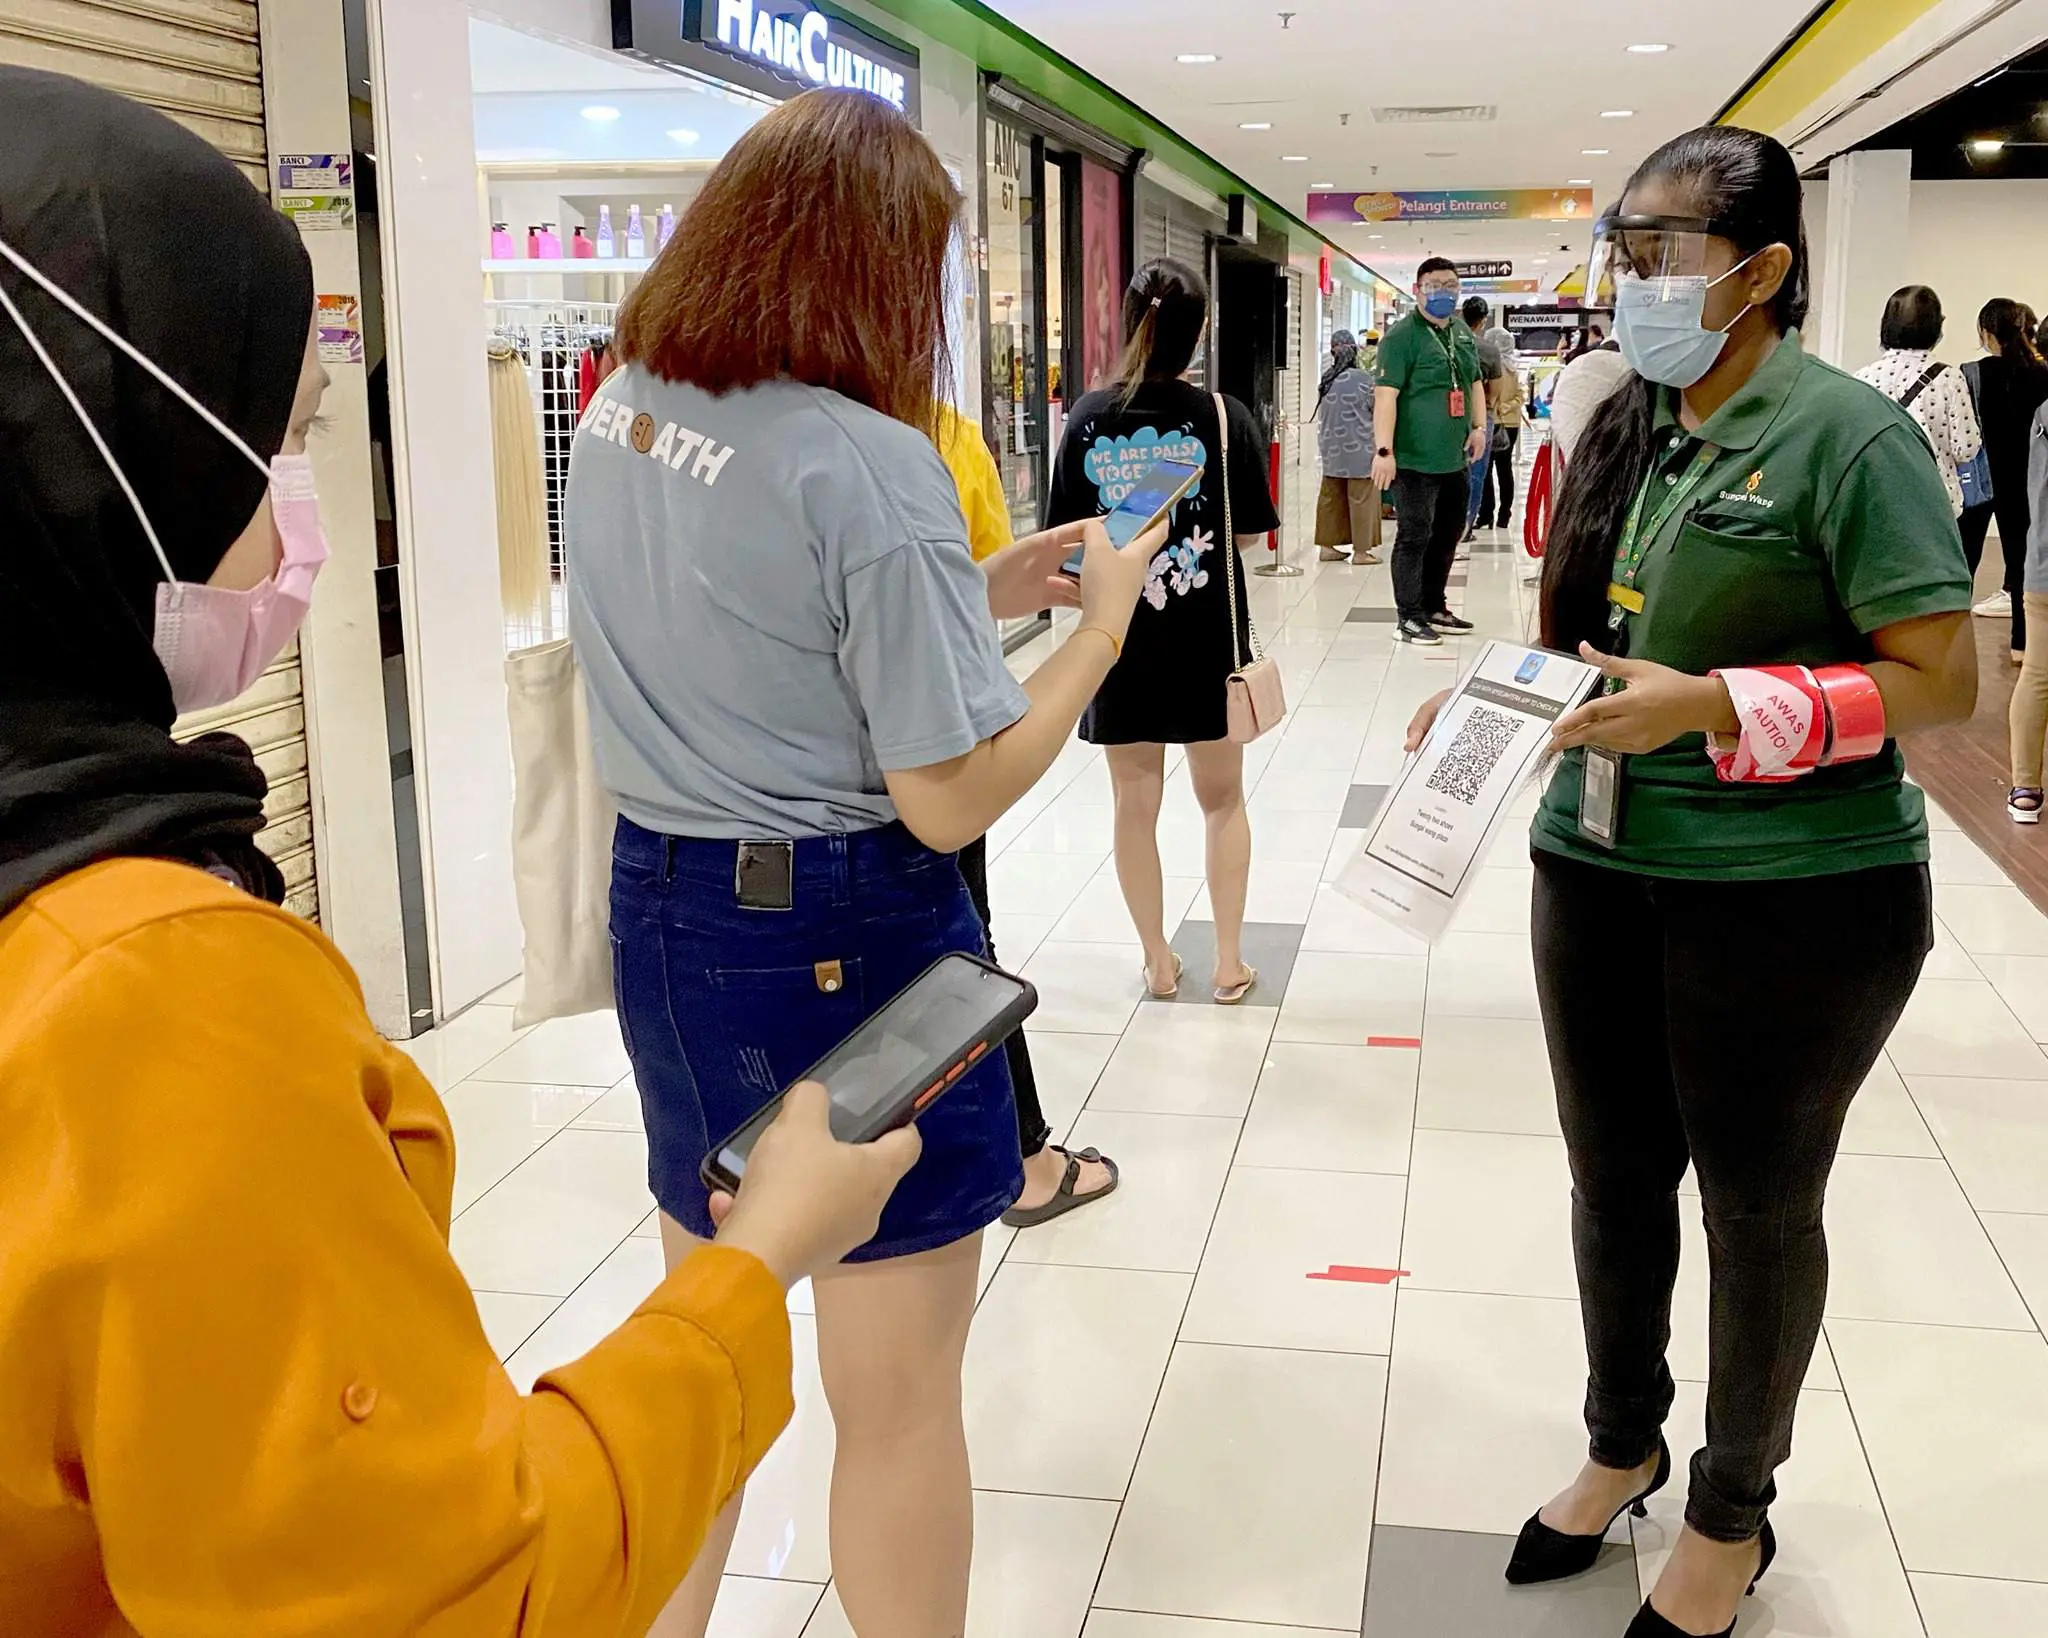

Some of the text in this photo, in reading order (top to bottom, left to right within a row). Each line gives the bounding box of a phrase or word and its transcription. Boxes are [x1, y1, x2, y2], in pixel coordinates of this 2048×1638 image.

[280, 157, 305, 165] BANCI
[1002, 181, 1014, 211] 67
[1399, 199, 1446, 214] Pelangi
[1450, 199, 1507, 211] Entrance
[1509, 315, 1563, 324] WENAWAVE
[1091, 440, 1200, 465] WE ARE PALS!
[1767, 695, 1805, 735] AWAS
